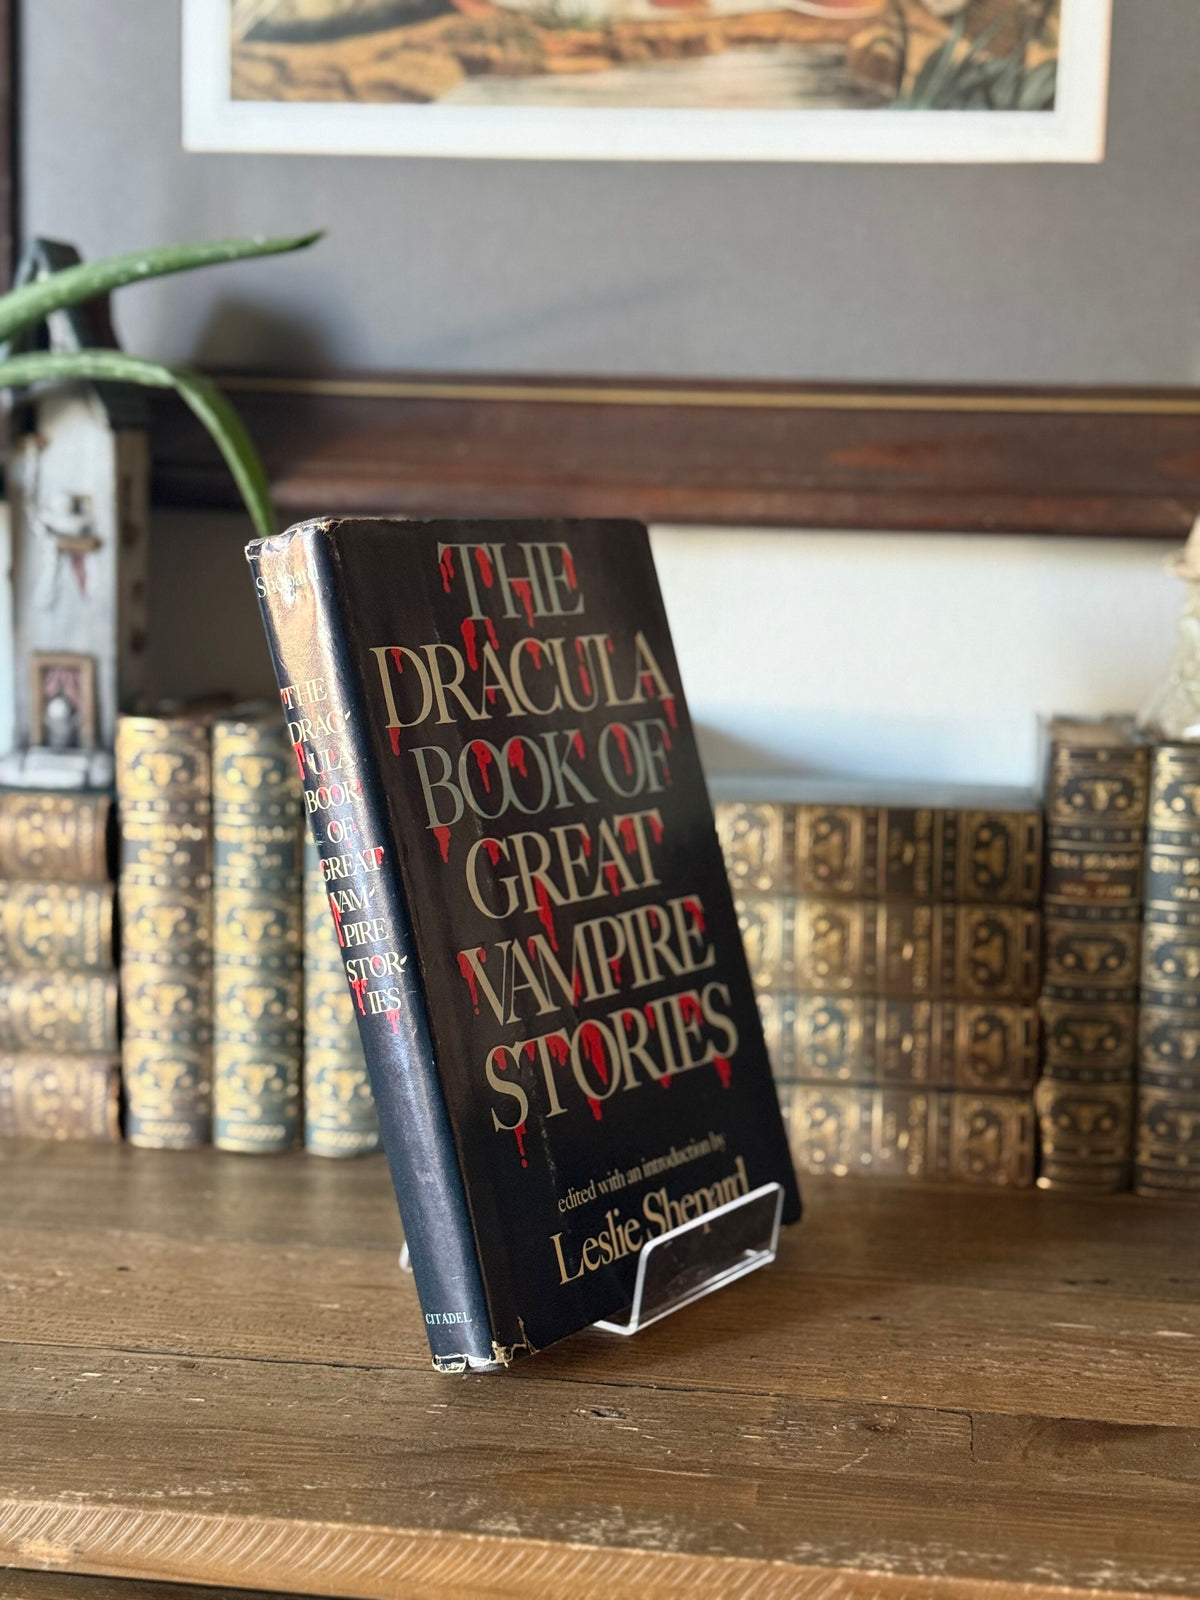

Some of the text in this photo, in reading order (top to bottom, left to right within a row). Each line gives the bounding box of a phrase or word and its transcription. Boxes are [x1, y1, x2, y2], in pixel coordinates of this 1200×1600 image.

[437, 541, 585, 620] THE
[280, 678, 328, 710] THE
[369, 630, 675, 728] DRACULA
[309, 744, 356, 775] ULA
[408, 718, 672, 829] BOOK OF
[304, 779, 364, 814] BOOK
[327, 816, 355, 843] OF
[319, 845, 384, 882] GREAT
[465, 807, 663, 919] GREAT
[343, 917, 390, 948] PIRE
[457, 894, 716, 1027] VAMPIRE
[367, 987, 401, 1015] IES
[485, 981, 739, 1132] STORIES
[558, 1131, 726, 1213] edited with an introduction by
[550, 1155, 750, 1285] Leslie Shepard
[425, 1311, 472, 1325] CITADEL
